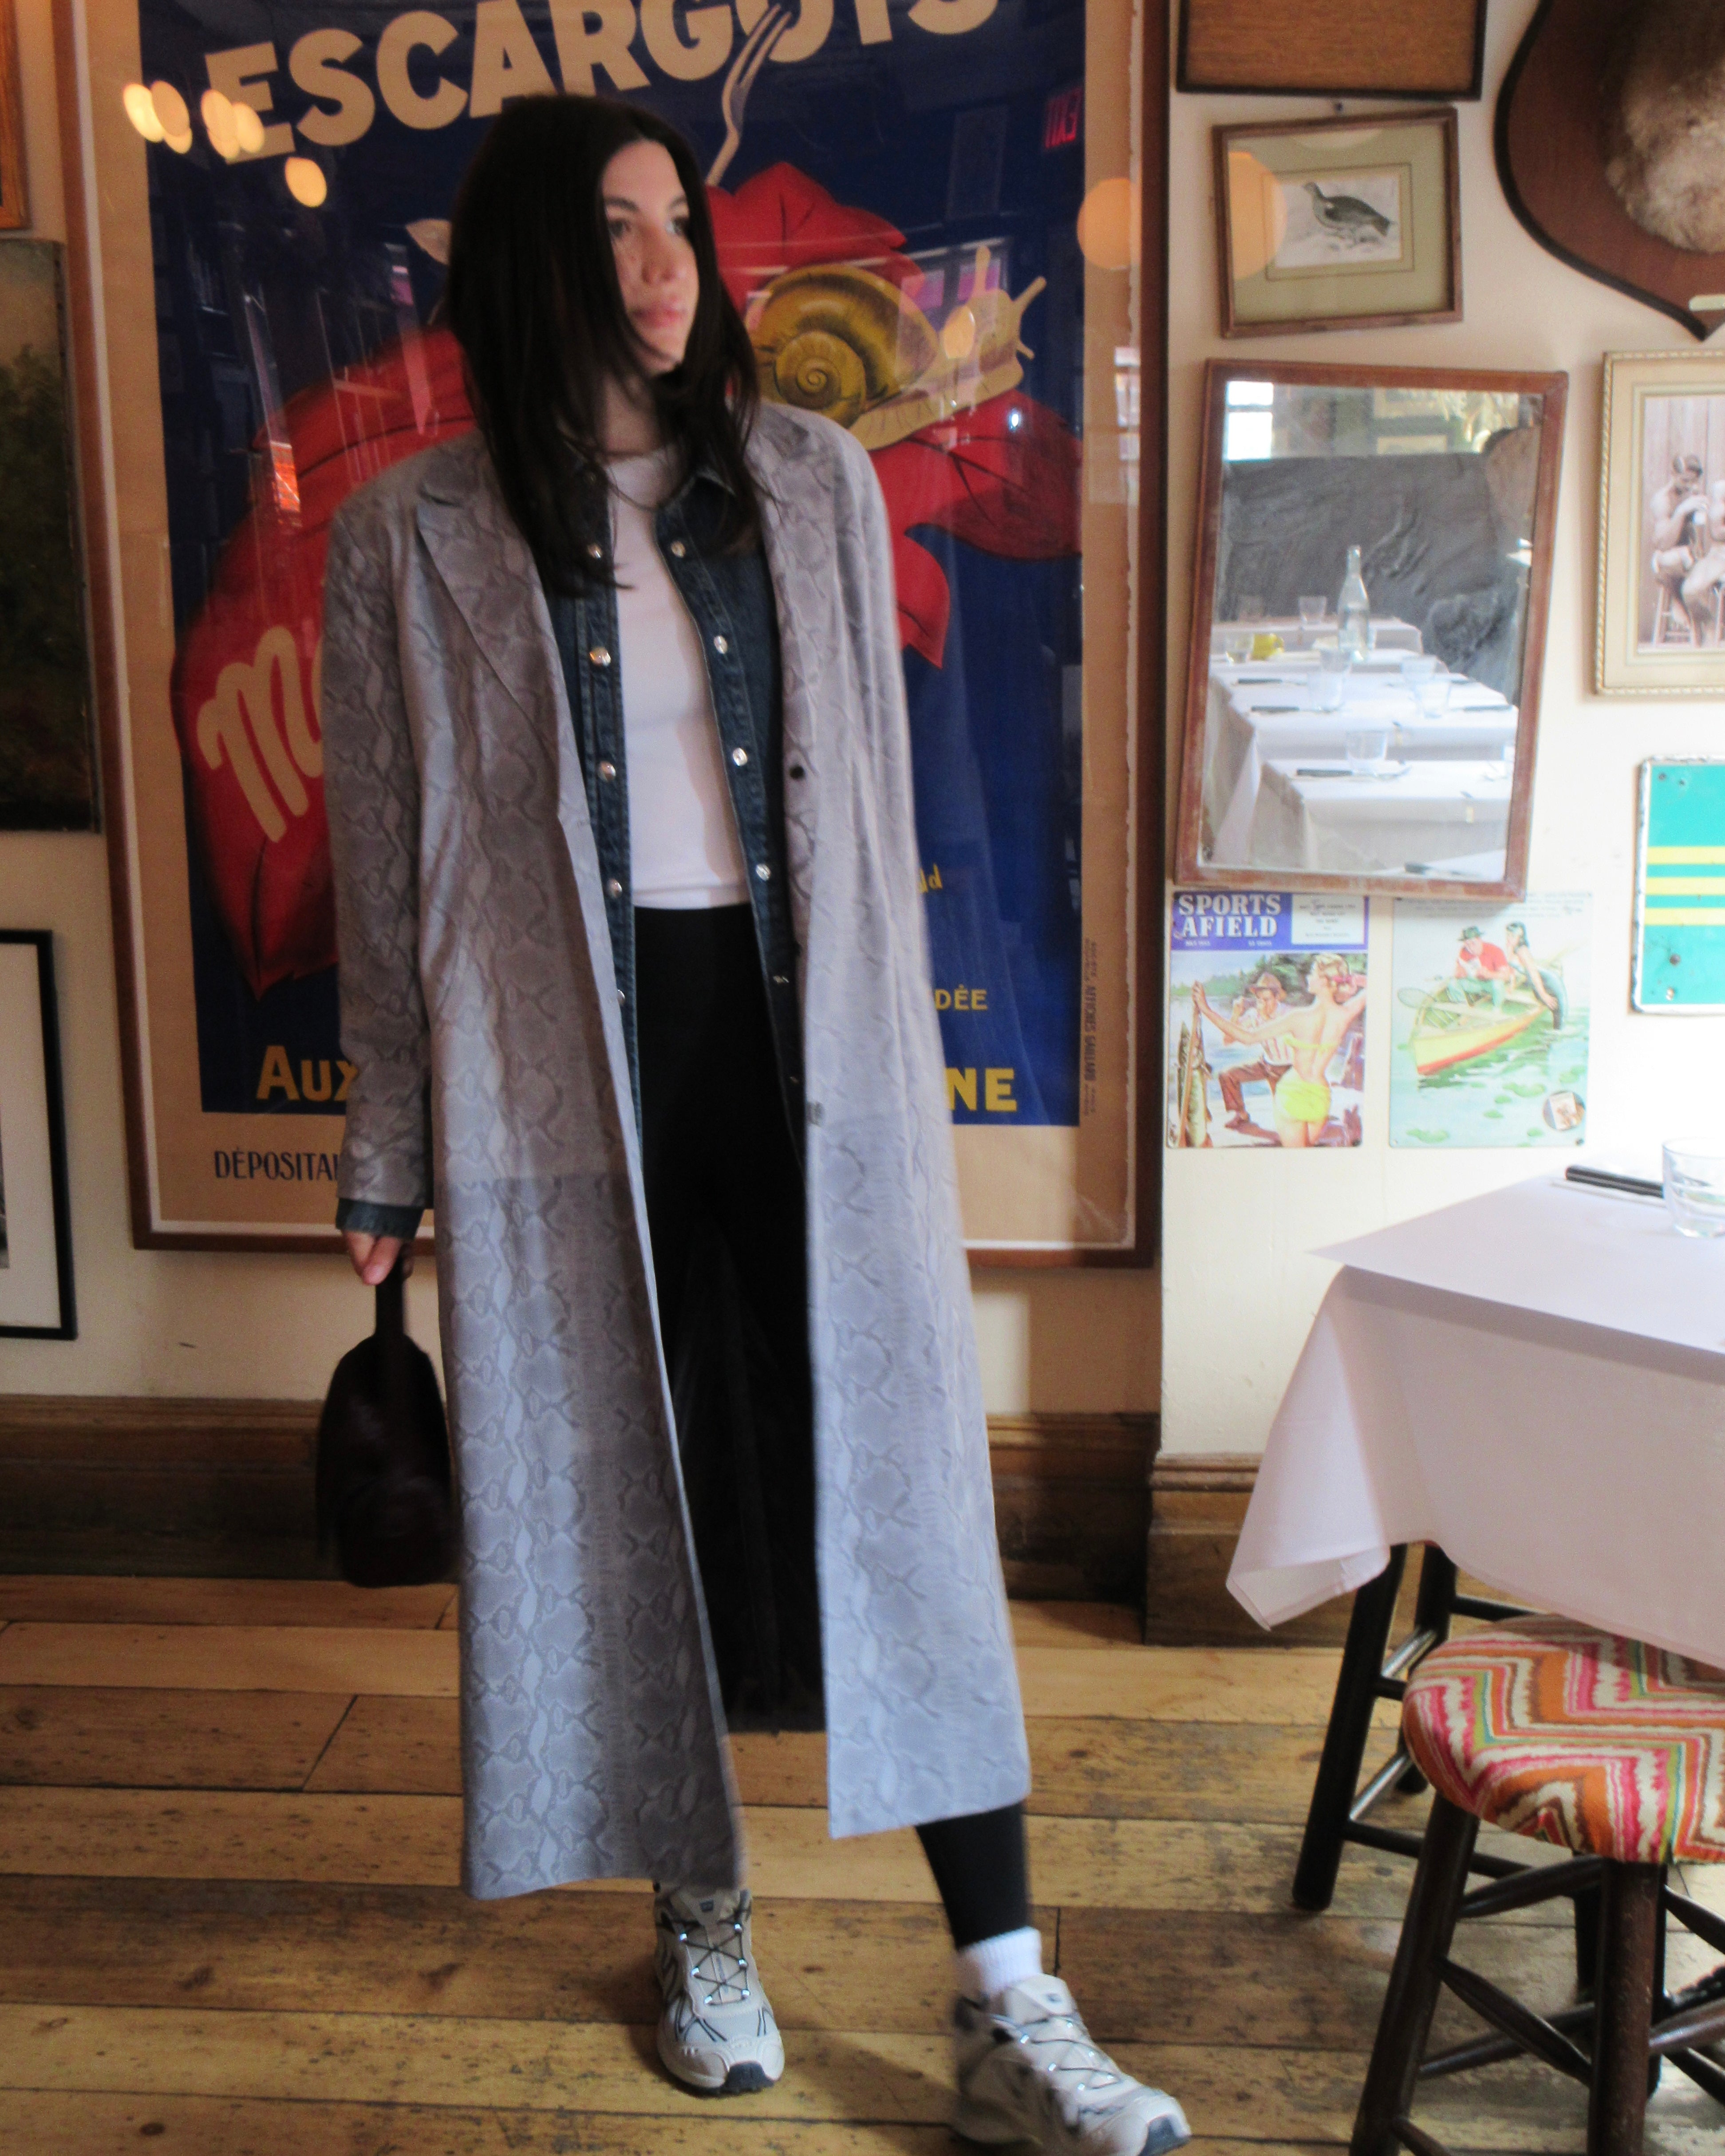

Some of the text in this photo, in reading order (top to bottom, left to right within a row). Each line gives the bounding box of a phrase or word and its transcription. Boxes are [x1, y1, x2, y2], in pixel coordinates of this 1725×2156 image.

[204, 0, 997, 165] ESCARG
[1178, 894, 1281, 916] SPORTS
[1182, 916, 1278, 938] AFIELD
